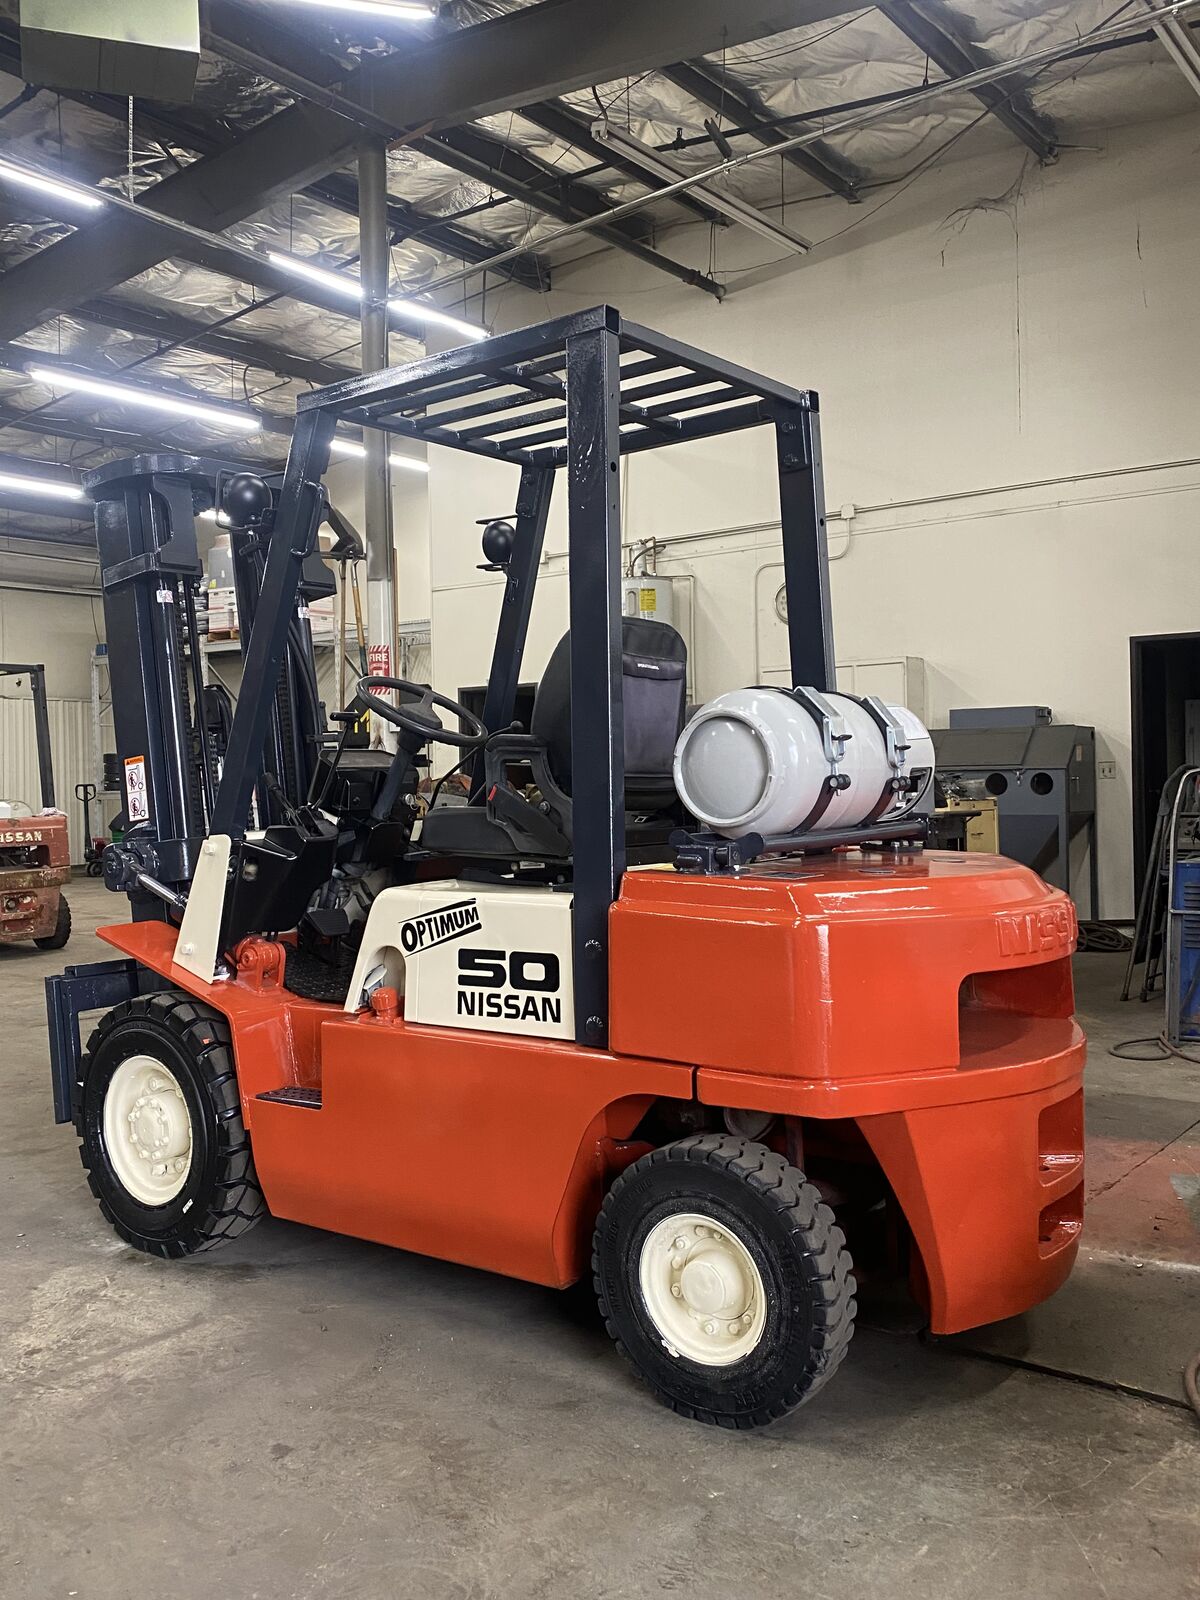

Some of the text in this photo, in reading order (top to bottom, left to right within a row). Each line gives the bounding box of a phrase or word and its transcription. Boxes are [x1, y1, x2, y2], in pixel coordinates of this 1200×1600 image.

[369, 653, 388, 662] FIRE
[401, 906, 480, 952] OPTIMUM
[457, 948, 560, 993] 50
[457, 991, 561, 1023] NISSAN
